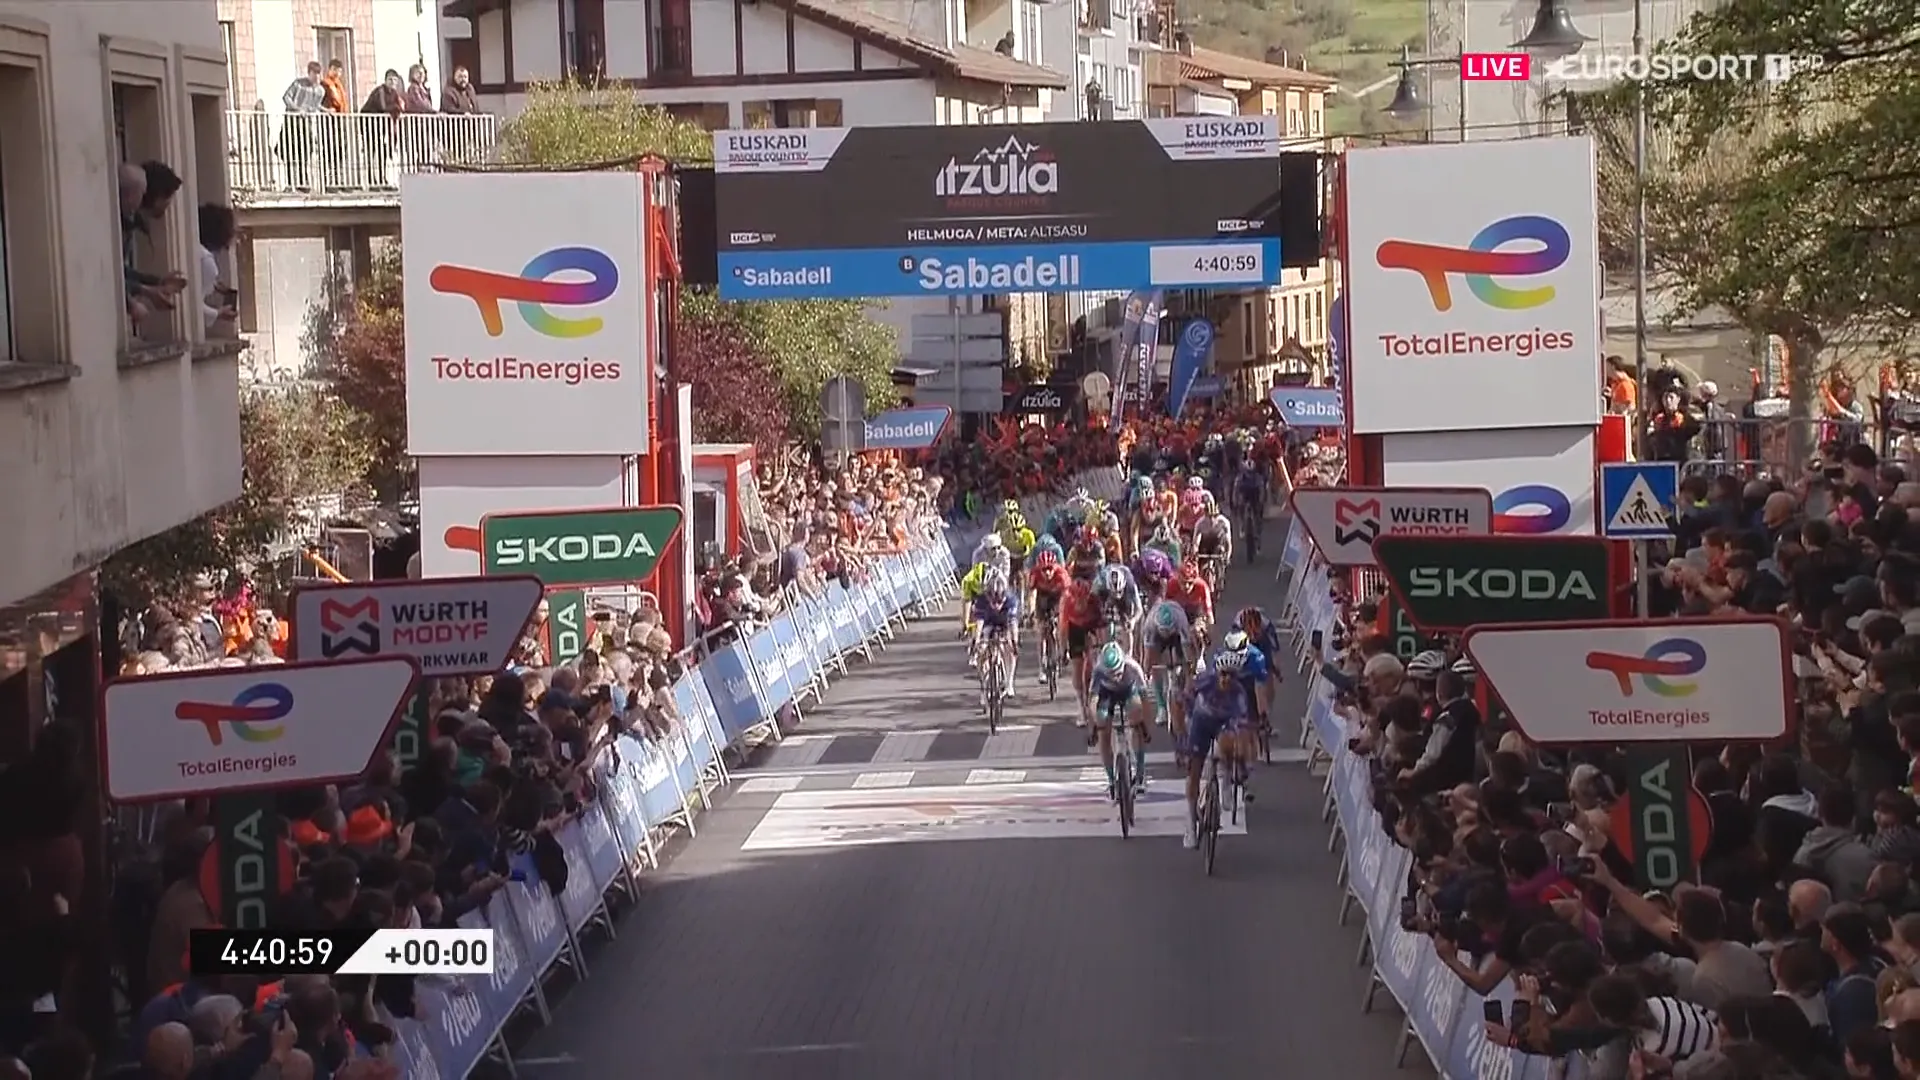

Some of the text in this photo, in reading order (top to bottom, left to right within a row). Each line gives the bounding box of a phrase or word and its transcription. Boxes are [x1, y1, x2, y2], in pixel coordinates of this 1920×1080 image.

[1185, 122, 1264, 138] EUSKADI
[729, 135, 807, 150] EUSKADI
[763, 151, 808, 162] COUNTRY
[908, 228, 974, 240] HELMUGA
[987, 227, 1027, 239] META:
[1030, 225, 1087, 237] ALTSASU
[920, 255, 1079, 289] Sabadell
[1194, 256, 1256, 272] 4:40:59
[744, 267, 831, 286] Sabadell
[1379, 328, 1573, 356] TotalEnergies
[431, 358, 620, 384] TotalEnergies
[1295, 400, 1341, 416] Saba
[866, 421, 934, 439] Sabadell
[393, 622, 488, 646] MODYF
[419, 652, 488, 668] RKWEAR
[1589, 709, 1710, 728] TotalEnergies
[178, 752, 297, 777] TotalEnergies
